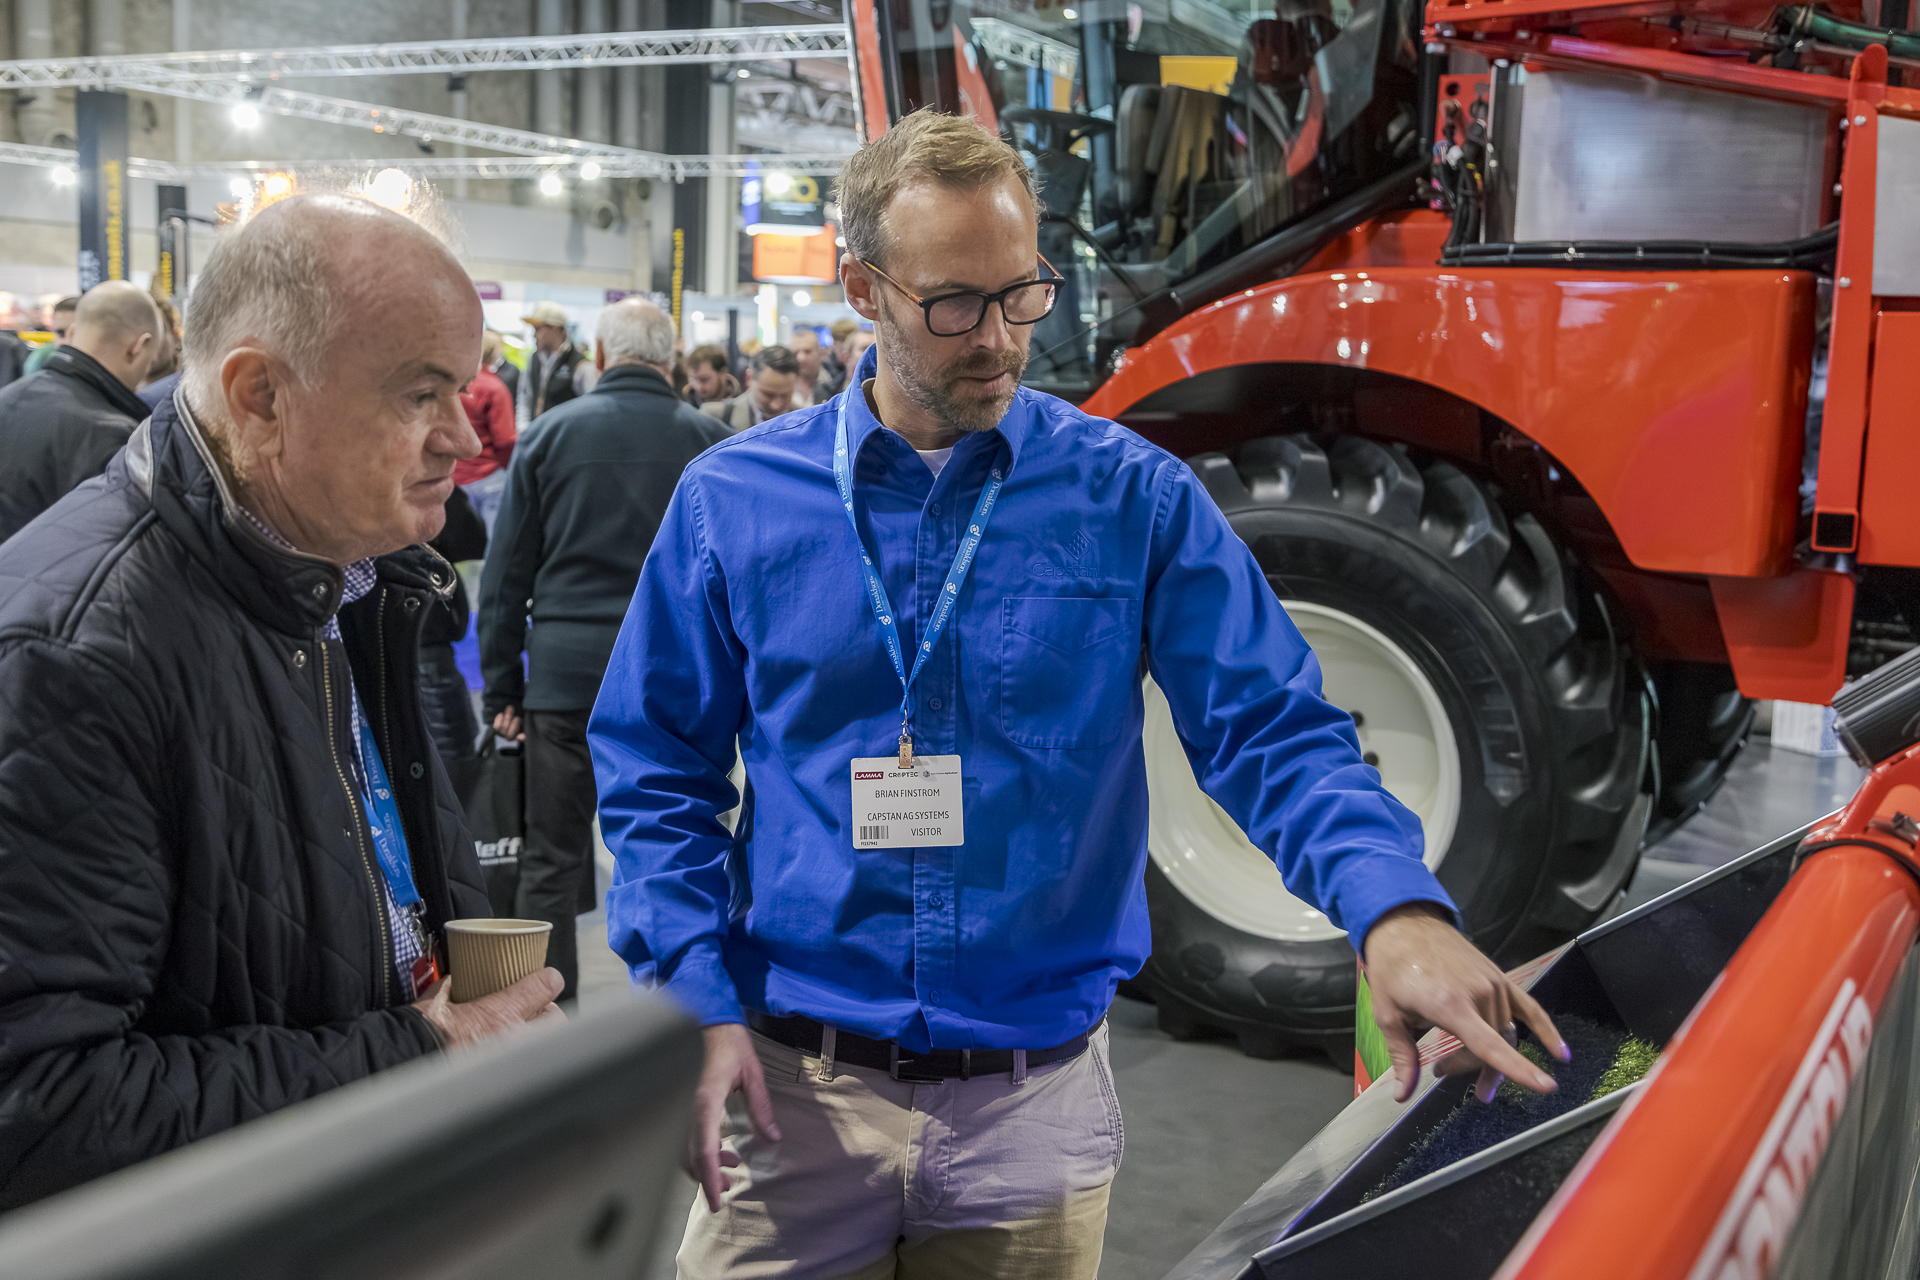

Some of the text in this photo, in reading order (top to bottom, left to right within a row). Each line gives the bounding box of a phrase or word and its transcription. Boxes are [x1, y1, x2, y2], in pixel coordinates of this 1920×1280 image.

[980, 481, 1000, 516] Donaldson
[957, 537, 977, 574] Donaldson
[1032, 563, 1120, 580] CapstanG
[870, 575, 884, 613] Donaldson
[933, 596, 954, 632] Donaldson
[875, 788, 940, 798] BRIAN FINSTROM
[867, 811, 950, 821] CAPSTAN AG SYSTEMS
[911, 827, 942, 836] VISITOR
